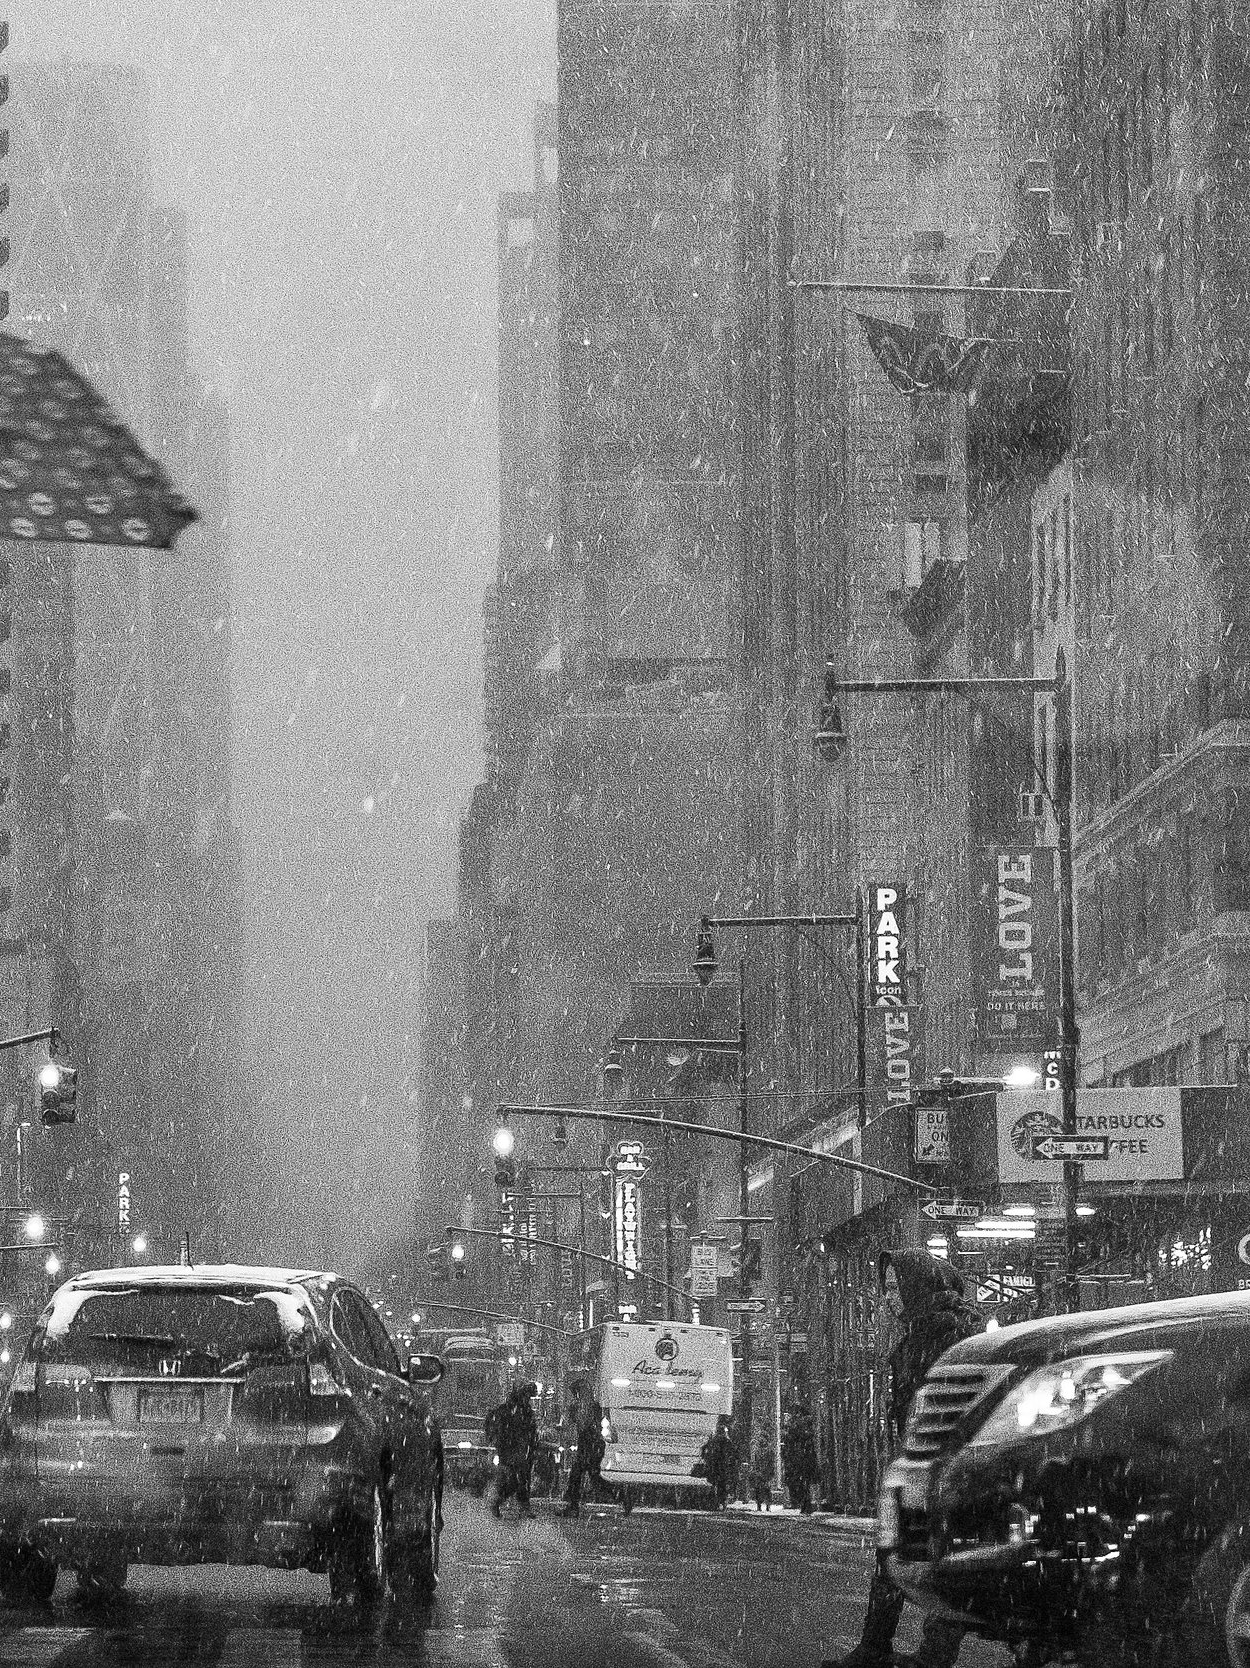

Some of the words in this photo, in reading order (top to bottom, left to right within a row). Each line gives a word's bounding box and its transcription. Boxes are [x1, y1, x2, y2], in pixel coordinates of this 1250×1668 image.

[876, 888, 900, 983] PARK
[997, 854, 1032, 980] LOVE
[1076, 1115, 1165, 1129] TARBUCKS
[1044, 1143, 1064, 1153] ONE
[119, 1173, 130, 1221] PARK
